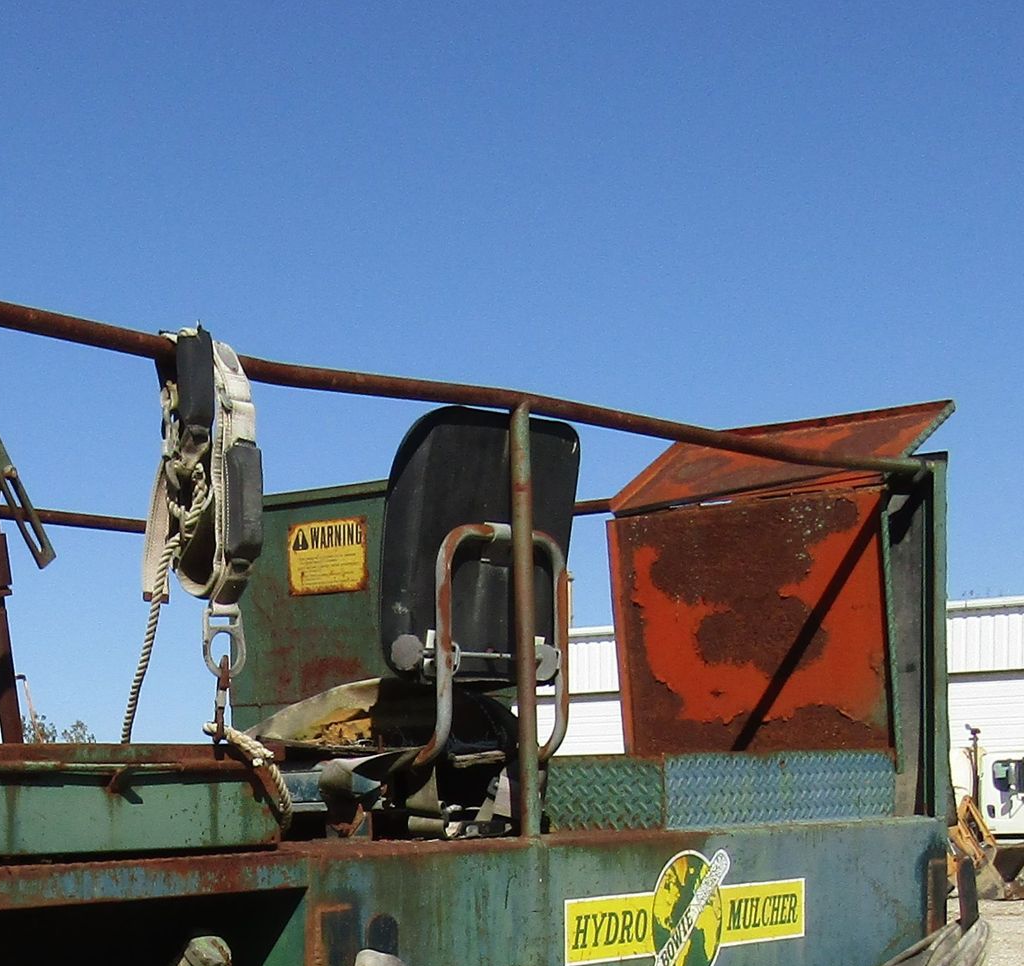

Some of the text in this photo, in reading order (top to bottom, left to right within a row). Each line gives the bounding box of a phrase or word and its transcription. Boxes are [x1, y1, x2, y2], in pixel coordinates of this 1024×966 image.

[310, 523, 362, 549] WARNING
[572, 909, 648, 949] HYDRO
[727, 893, 798, 930] MULCHER
